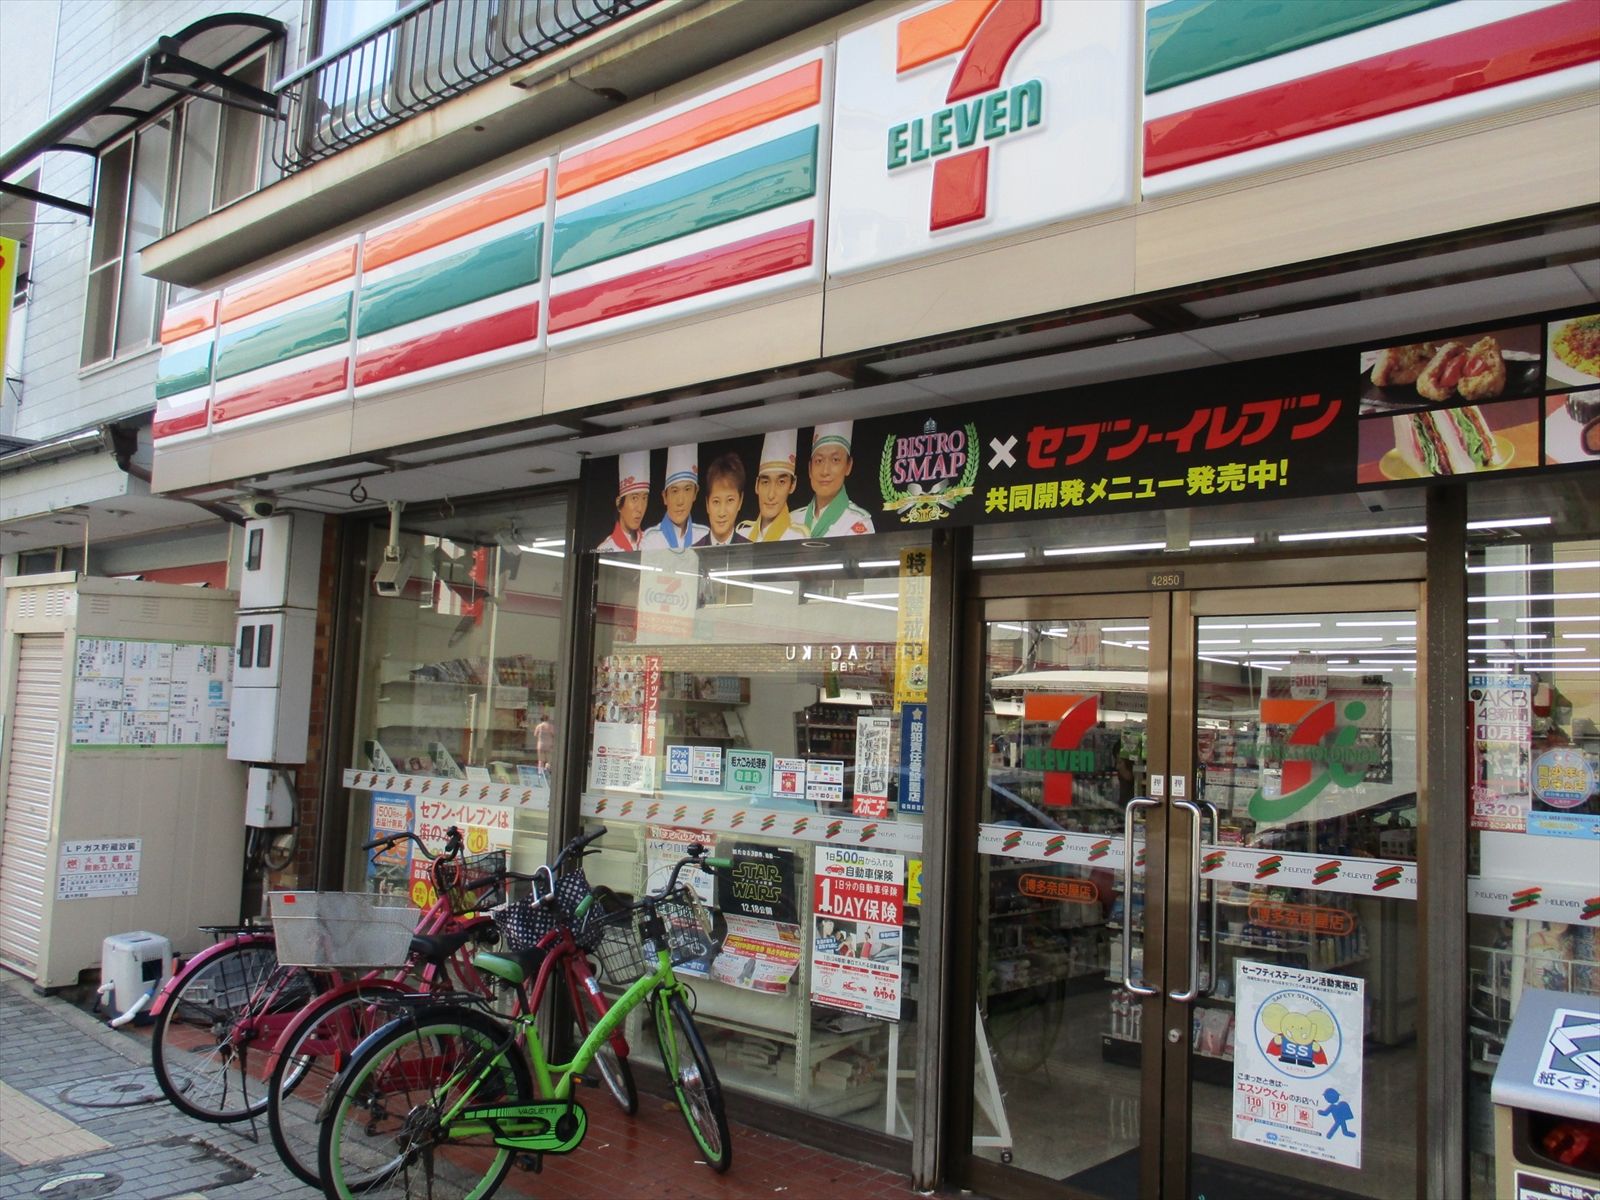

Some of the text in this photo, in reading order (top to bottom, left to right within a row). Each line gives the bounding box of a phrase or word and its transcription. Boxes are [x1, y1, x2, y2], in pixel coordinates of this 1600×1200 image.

[887, 79, 1042, 170] ELEVEN
[896, 429, 965, 460] BISTRO
[892, 453, 967, 486] SMAP
[985, 459, 1289, 514] 共同開発メニュー発売中!
[1151, 575, 1180, 587] 42850
[1479, 690, 1527, 707] AKB
[1478, 726, 1530, 740] 10月号
[1025, 750, 1096, 772] ELEVEN
[732, 862, 783, 883] STAR
[846, 866, 894, 882] 自動車保険
[732, 881, 782, 904] WARS
[834, 879, 898, 897] 1日分の自動車保険
[819, 878, 898, 924] 1DAY保険
[1241, 965, 1359, 992] セーフティステーション活動実施店
[1285, 1043, 1309, 1057] SS
[1246, 1096, 1287, 1113] 110 119
